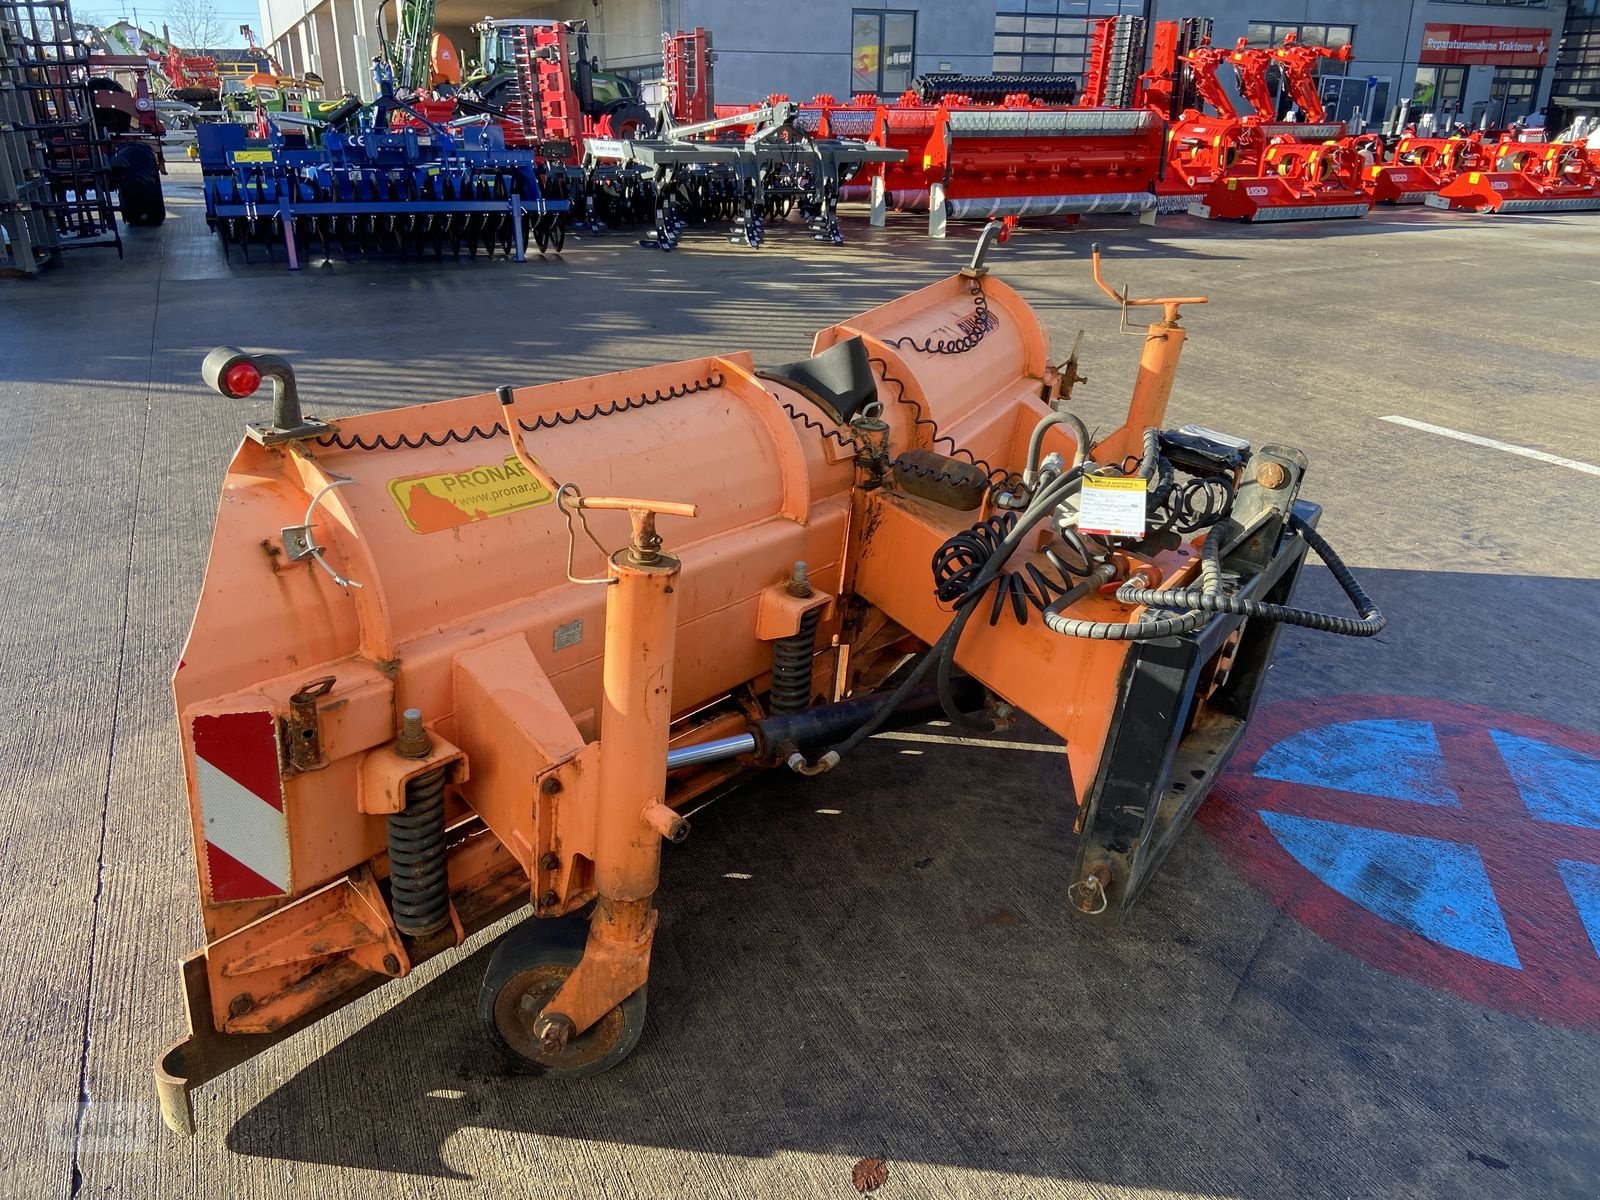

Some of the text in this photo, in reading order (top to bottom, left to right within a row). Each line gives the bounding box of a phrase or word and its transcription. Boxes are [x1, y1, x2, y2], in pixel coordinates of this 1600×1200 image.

[1427, 38, 1533, 52] Reparaturannahme Traktoren
[441, 463, 530, 492] PRONAR
[459, 481, 542, 506] www.pronar.pl
